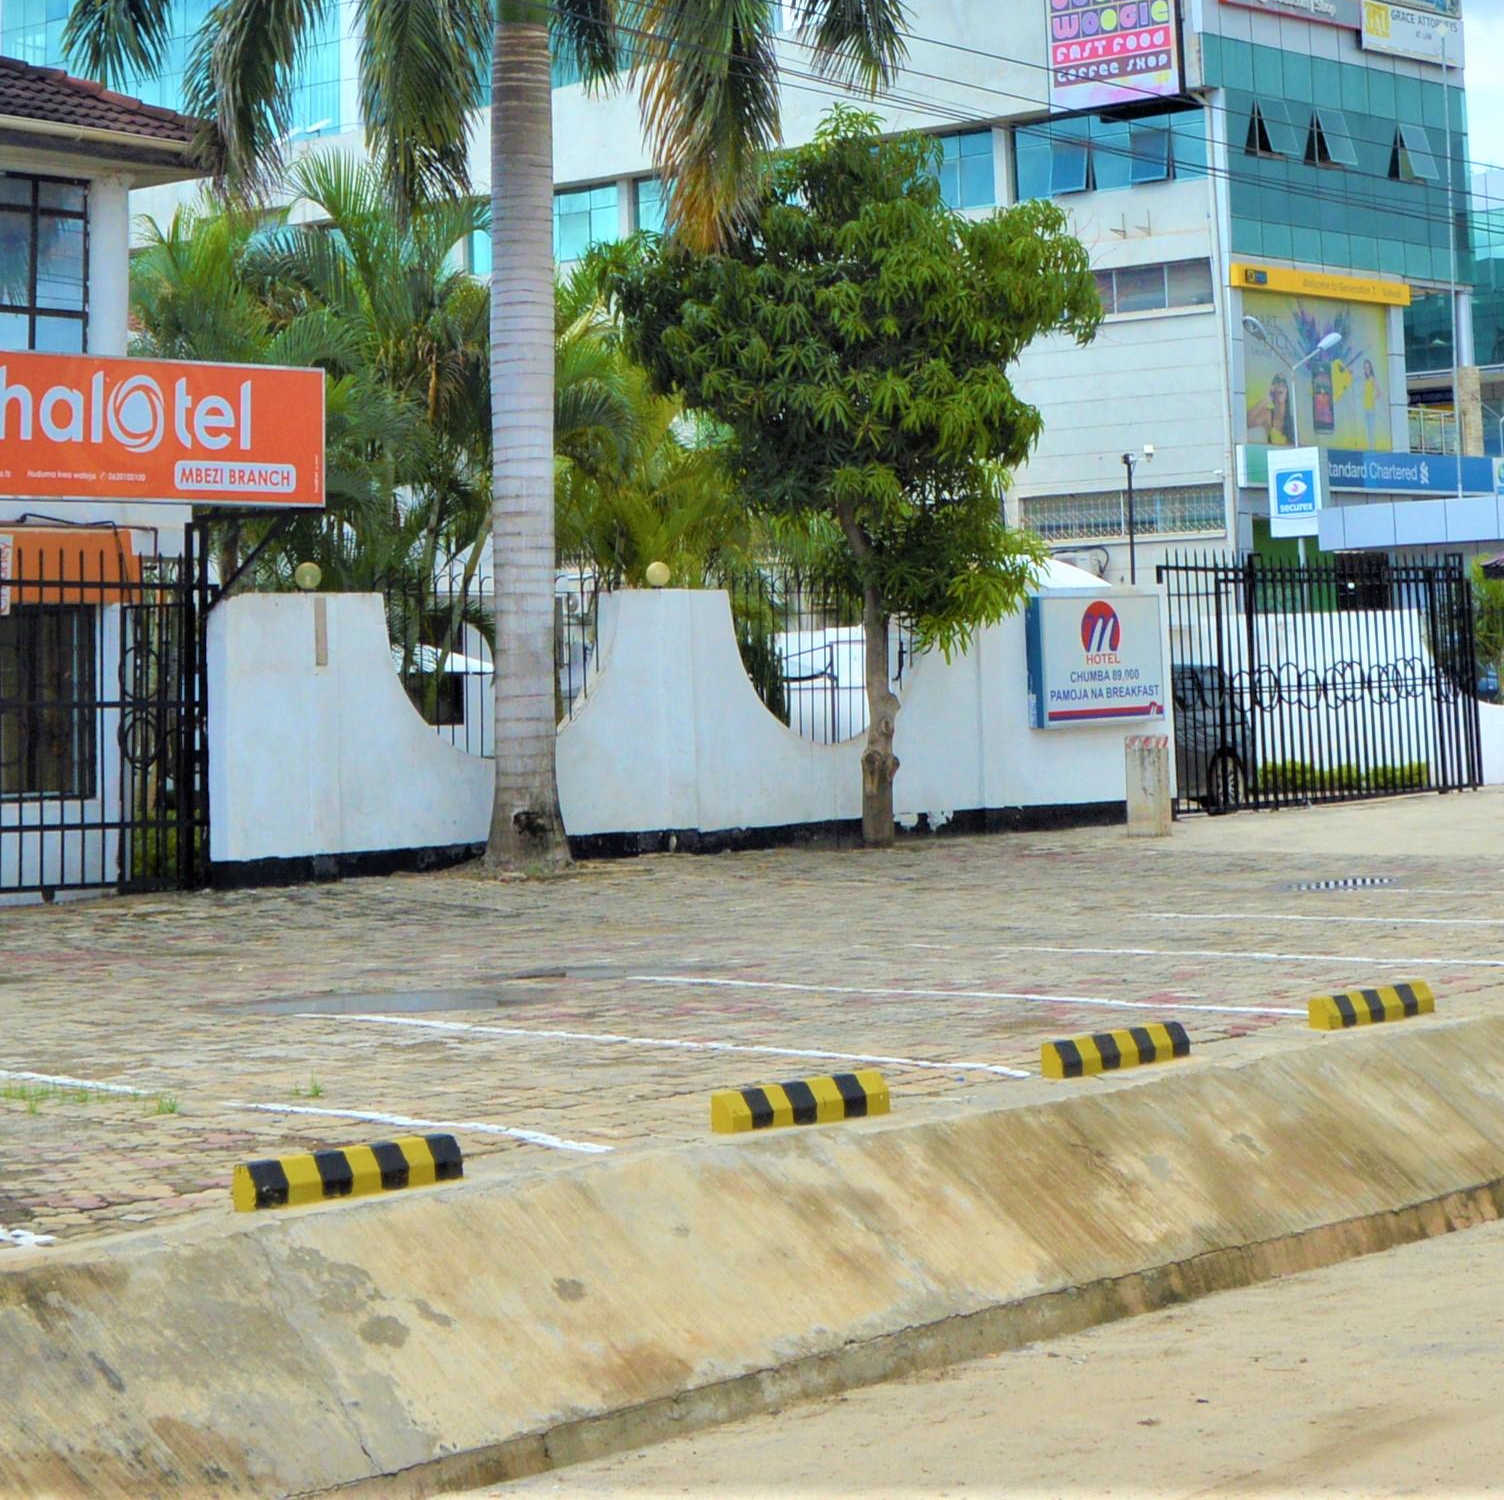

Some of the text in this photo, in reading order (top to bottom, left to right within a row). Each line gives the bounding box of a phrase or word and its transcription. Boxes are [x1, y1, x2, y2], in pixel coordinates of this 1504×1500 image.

[180, 466, 224, 486] MBEZI
[229, 467, 291, 488] BRANCH
[1370, 462, 1418, 481] Chartered
[1279, 503, 1314, 513] securex
[1086, 653, 1121, 665] HOTEL
[1070, 668, 1140, 683] CHUMBA 89,000
[1050, 684, 1160, 702] PAMOJA NA BREAKFAST
